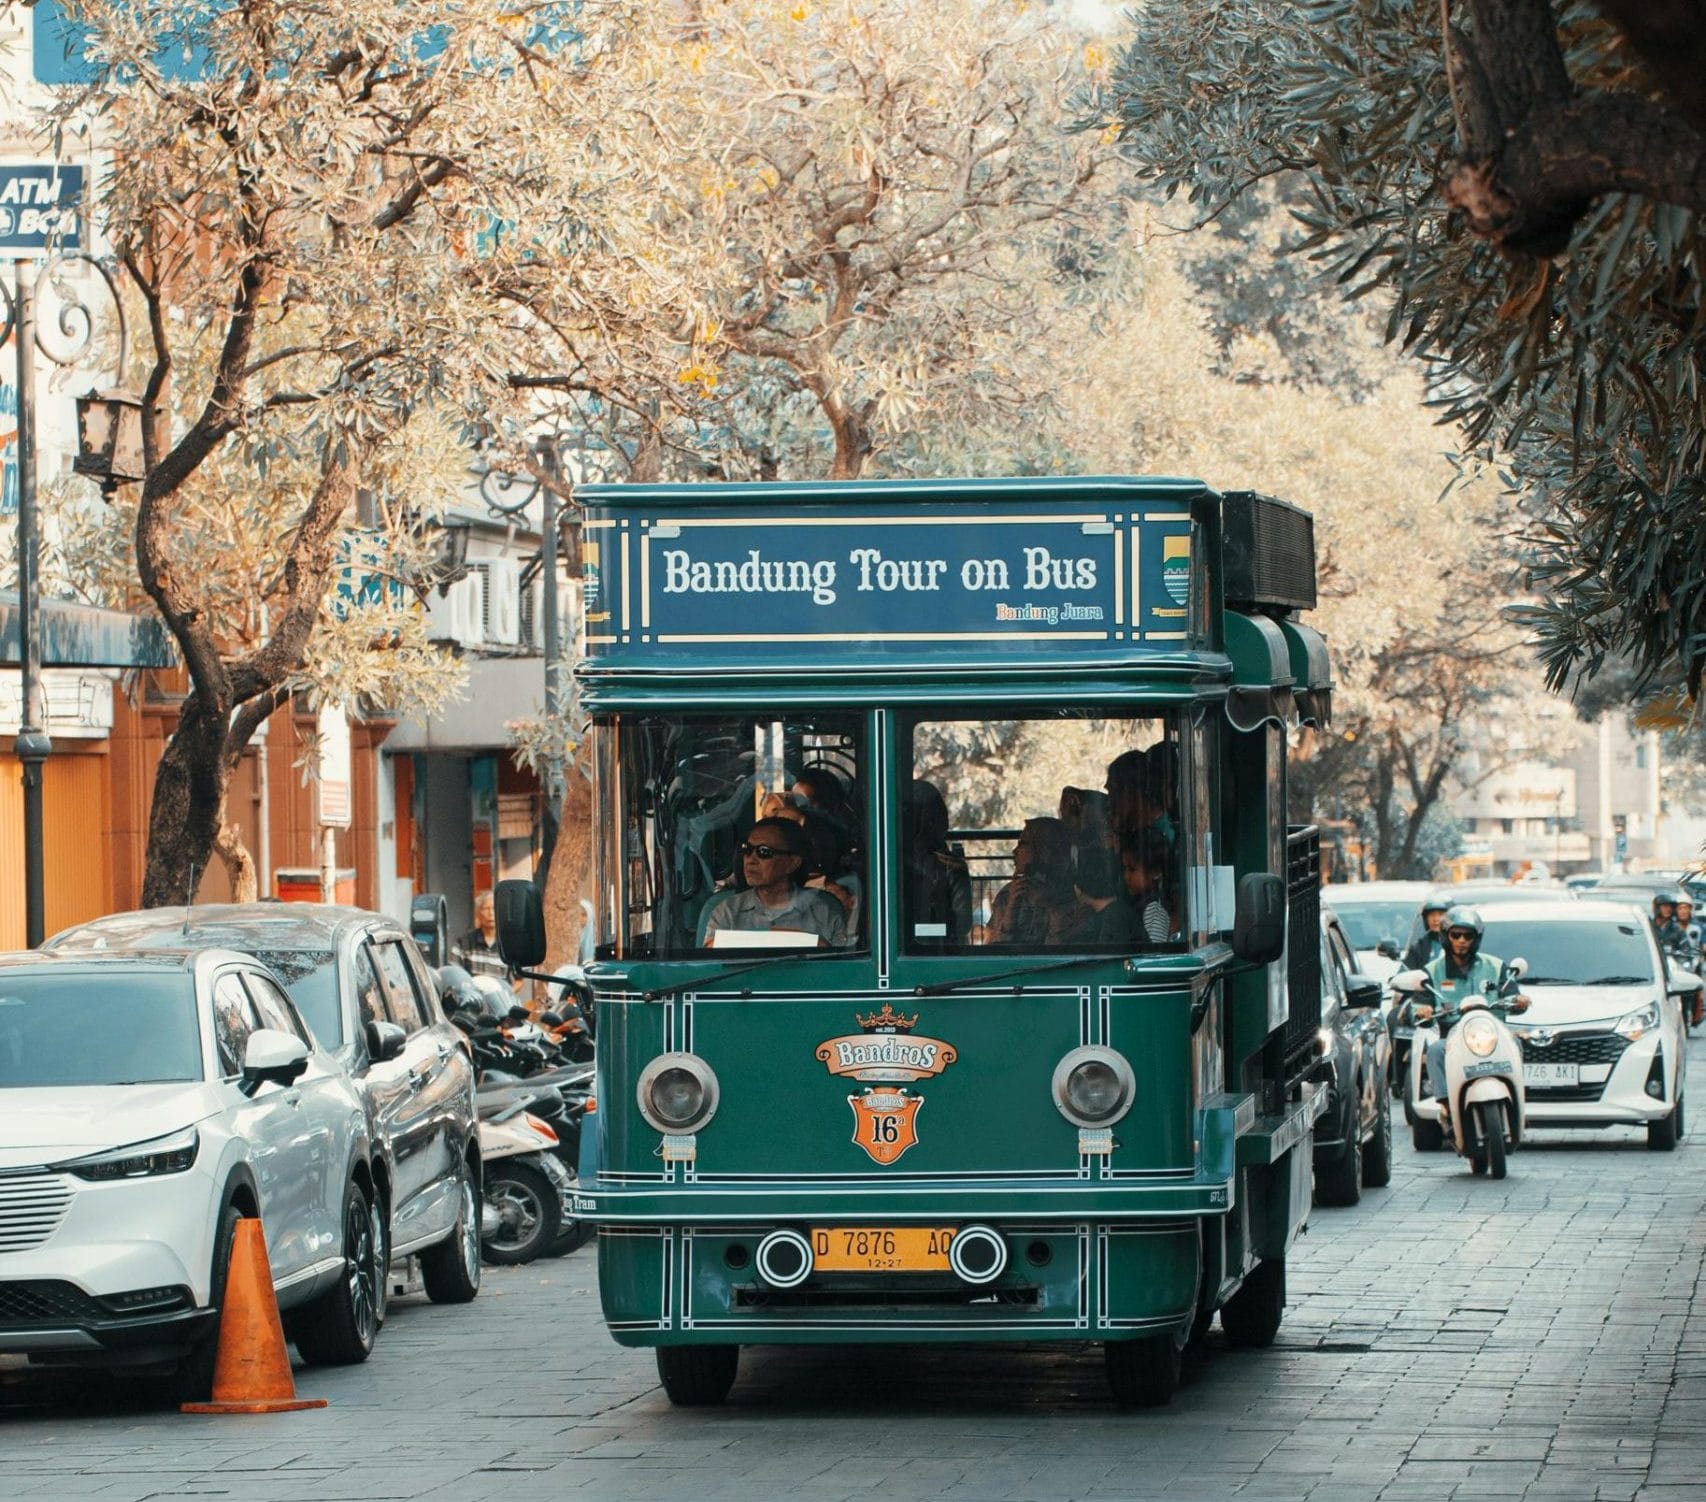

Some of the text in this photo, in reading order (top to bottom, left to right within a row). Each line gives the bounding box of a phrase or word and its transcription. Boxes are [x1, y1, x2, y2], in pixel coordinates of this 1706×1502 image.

[0, 177, 62, 204] ATM
[663, 547, 1097, 605] Bandung Tour on Bus
[996, 603, 1103, 624] Bandung Juara
[835, 1037, 937, 1068] Bandros
[573, 1195, 597, 1210] Tram
[817, 1232, 829, 1255] D
[843, 1231, 895, 1255] 7876
